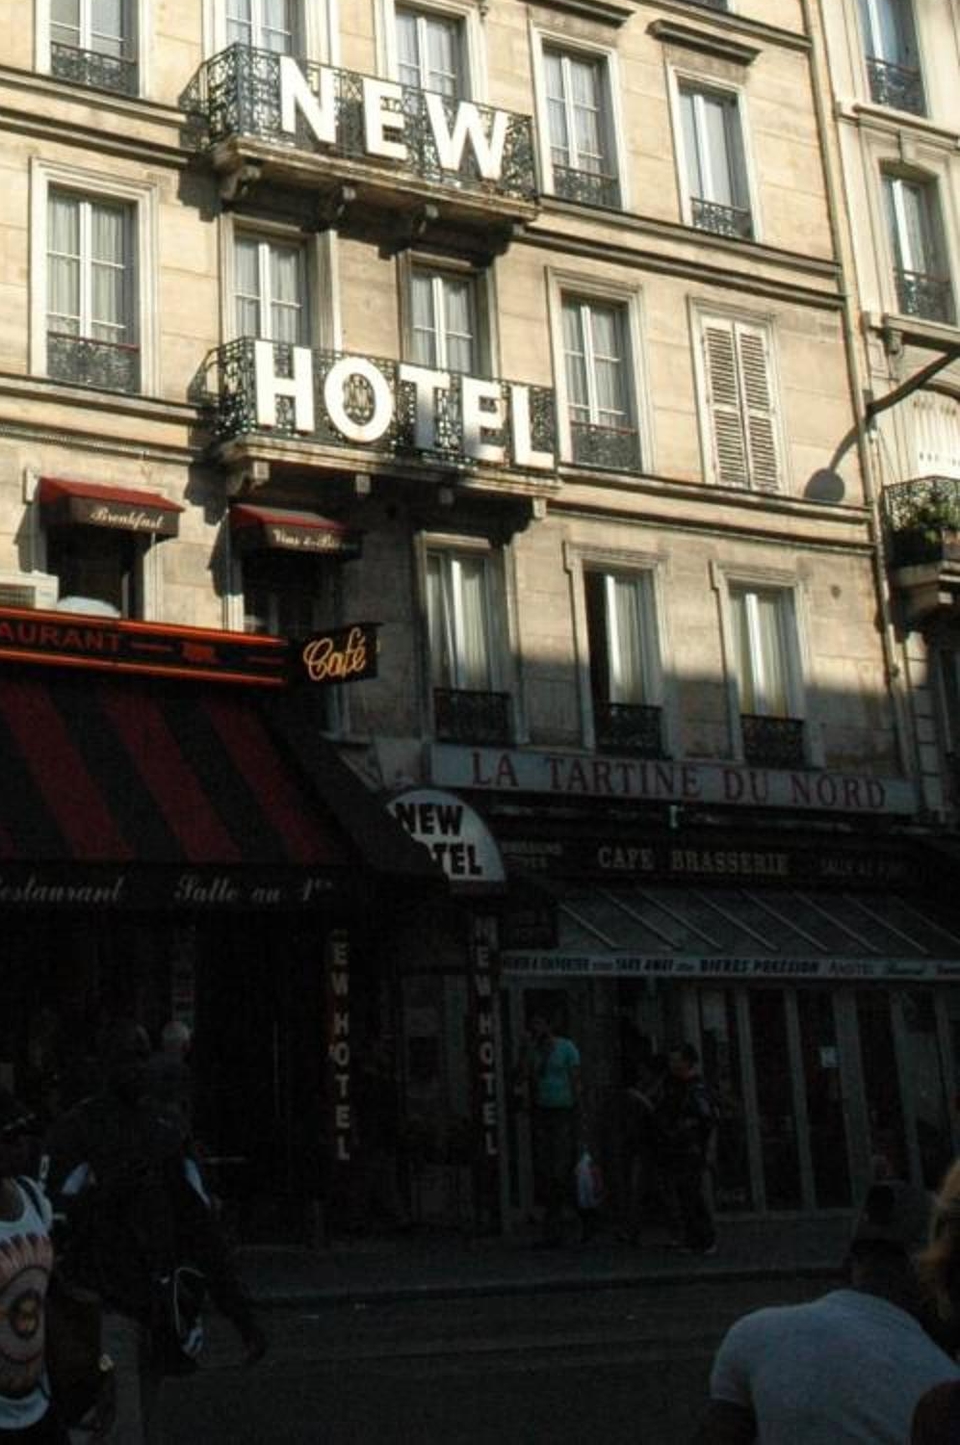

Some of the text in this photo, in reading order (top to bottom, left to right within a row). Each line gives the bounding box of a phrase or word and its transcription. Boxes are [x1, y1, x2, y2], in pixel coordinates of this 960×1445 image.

[279, 56, 510, 180] NEW
[254, 341, 555, 468] HOTEL
[89, 506, 165, 531] Breakfast
[303, 625, 367, 682] Café
[471, 754, 888, 808] LA TARTINE DU NORD
[395, 802, 463, 835] NEW
[428, 842, 483, 875] TEL
[670, 849, 790, 876] BRASSERIE
[173, 875, 236, 903] Salle
[251, 885, 281, 903] au
[332, 1010, 352, 1162] HOTEL
[479, 1011, 502, 1156] HOTEL
